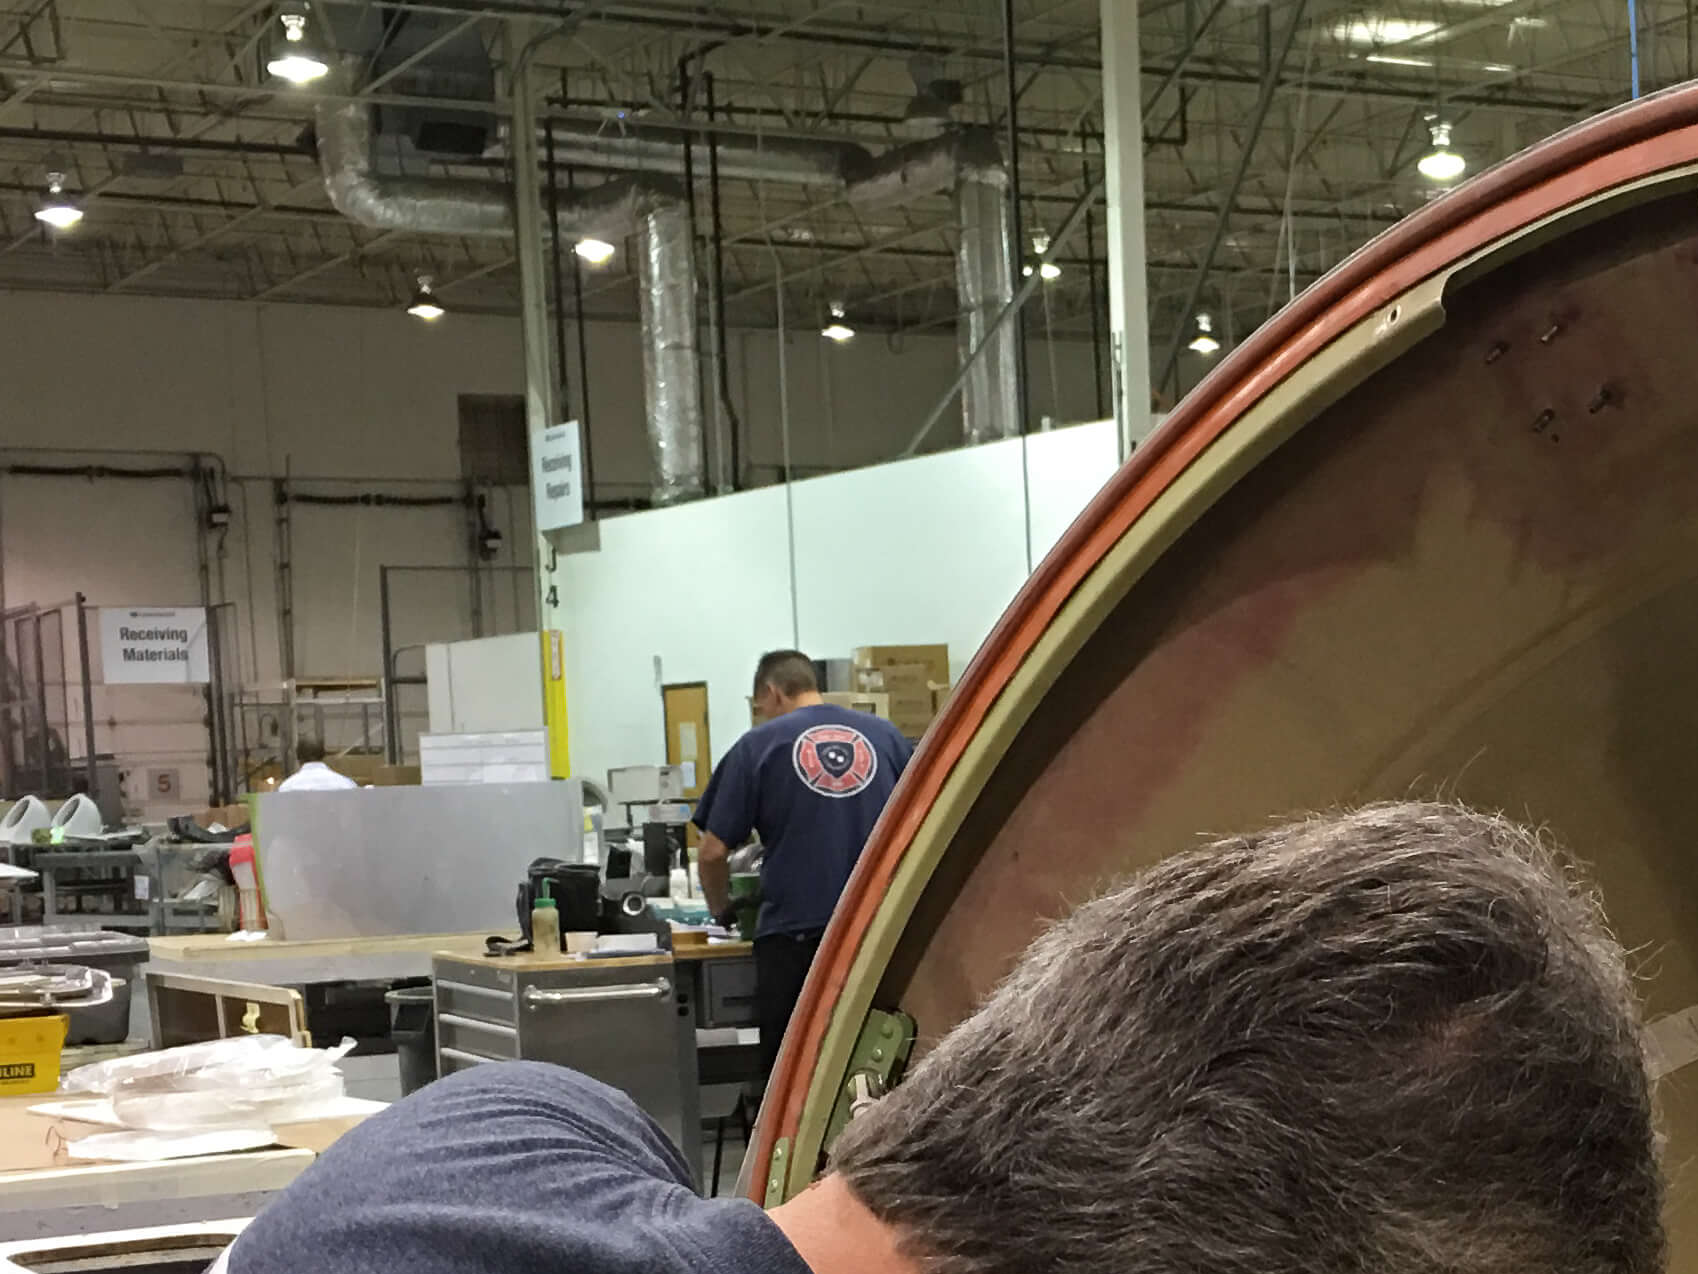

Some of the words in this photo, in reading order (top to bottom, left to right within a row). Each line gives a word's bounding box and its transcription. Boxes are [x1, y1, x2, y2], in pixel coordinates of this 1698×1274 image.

[546, 585, 560, 608] 4
[120, 627, 188, 643] Receiving
[123, 648, 189, 662] Materials
[157, 774, 172, 793] 5
[0, 1065, 32, 1078] LINE
